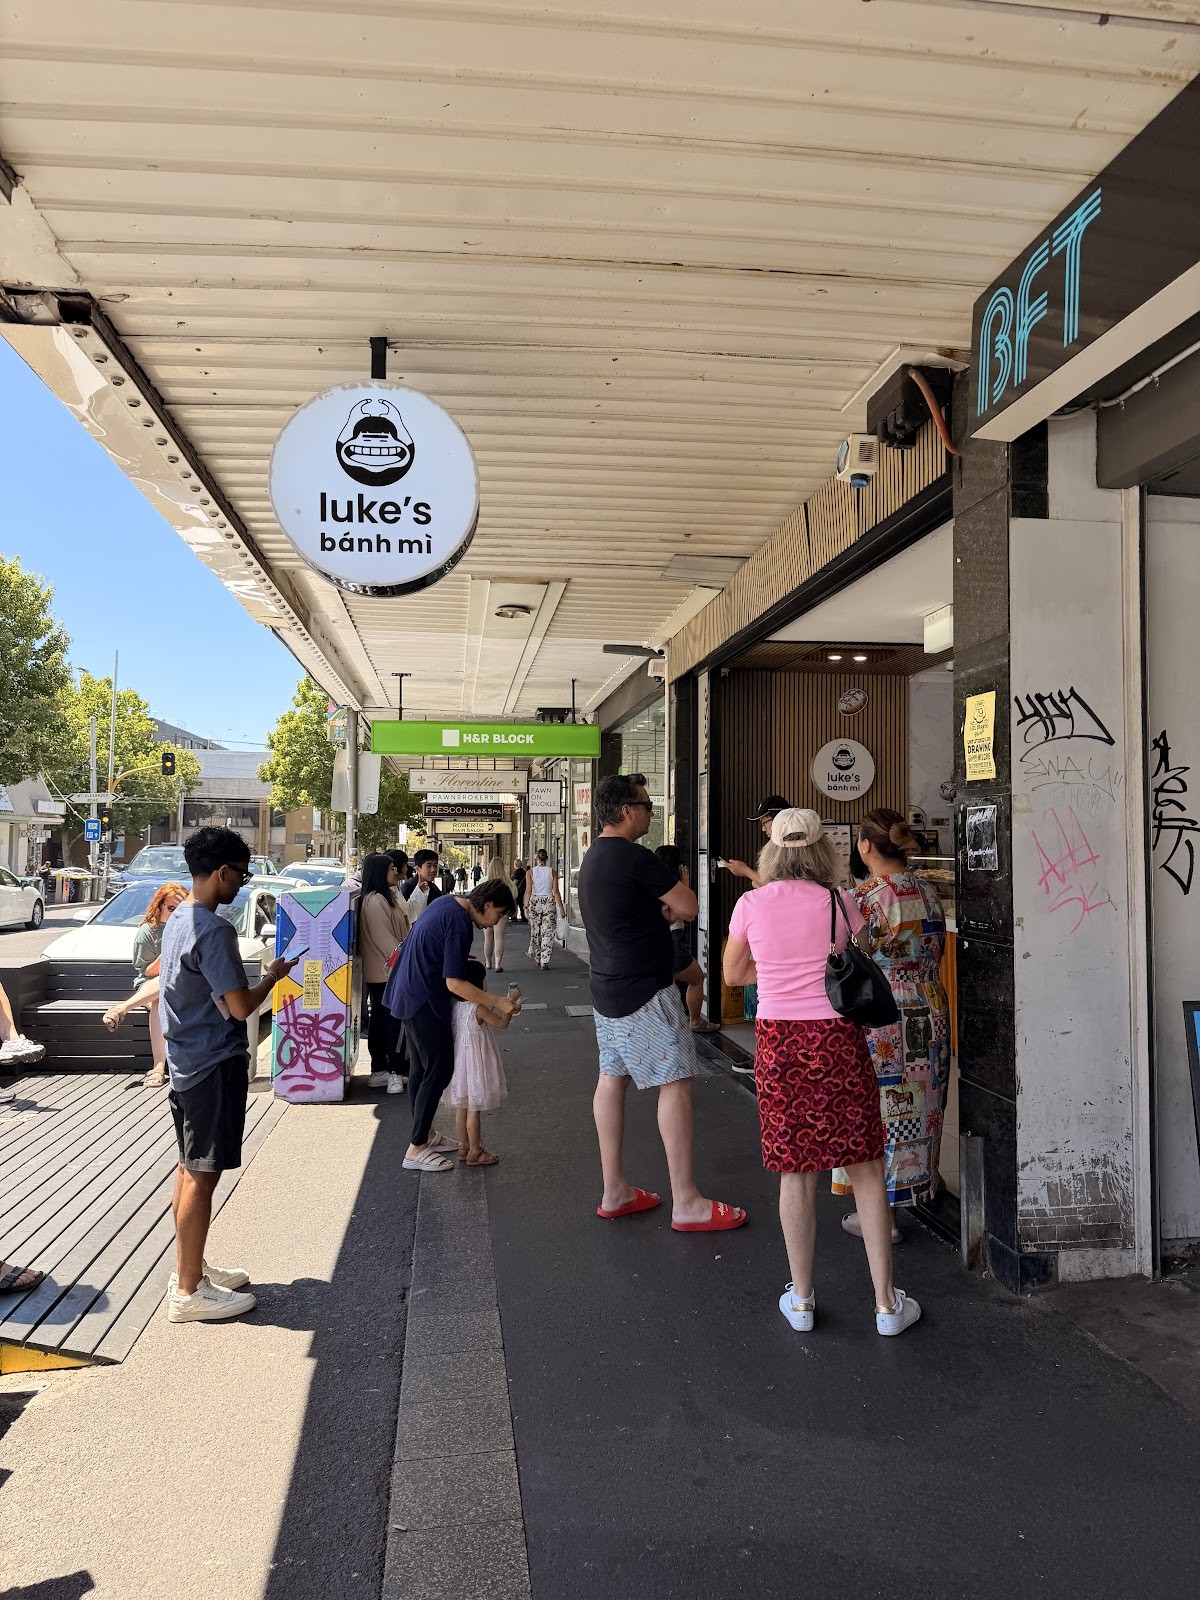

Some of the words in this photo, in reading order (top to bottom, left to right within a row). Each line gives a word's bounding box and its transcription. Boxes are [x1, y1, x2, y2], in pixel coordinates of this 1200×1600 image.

[977, 187, 1102, 417] BFT
[320, 531, 391, 553] bánh
[398, 533, 432, 554] mì
[463, 733, 490, 744] H&R
[492, 734, 535, 744] BLOCK
[967, 742, 991, 754] DRAWING
[433, 772, 505, 787] Florentine
[827, 783, 849, 791] bánh
[425, 806, 463, 814] FRESCO
